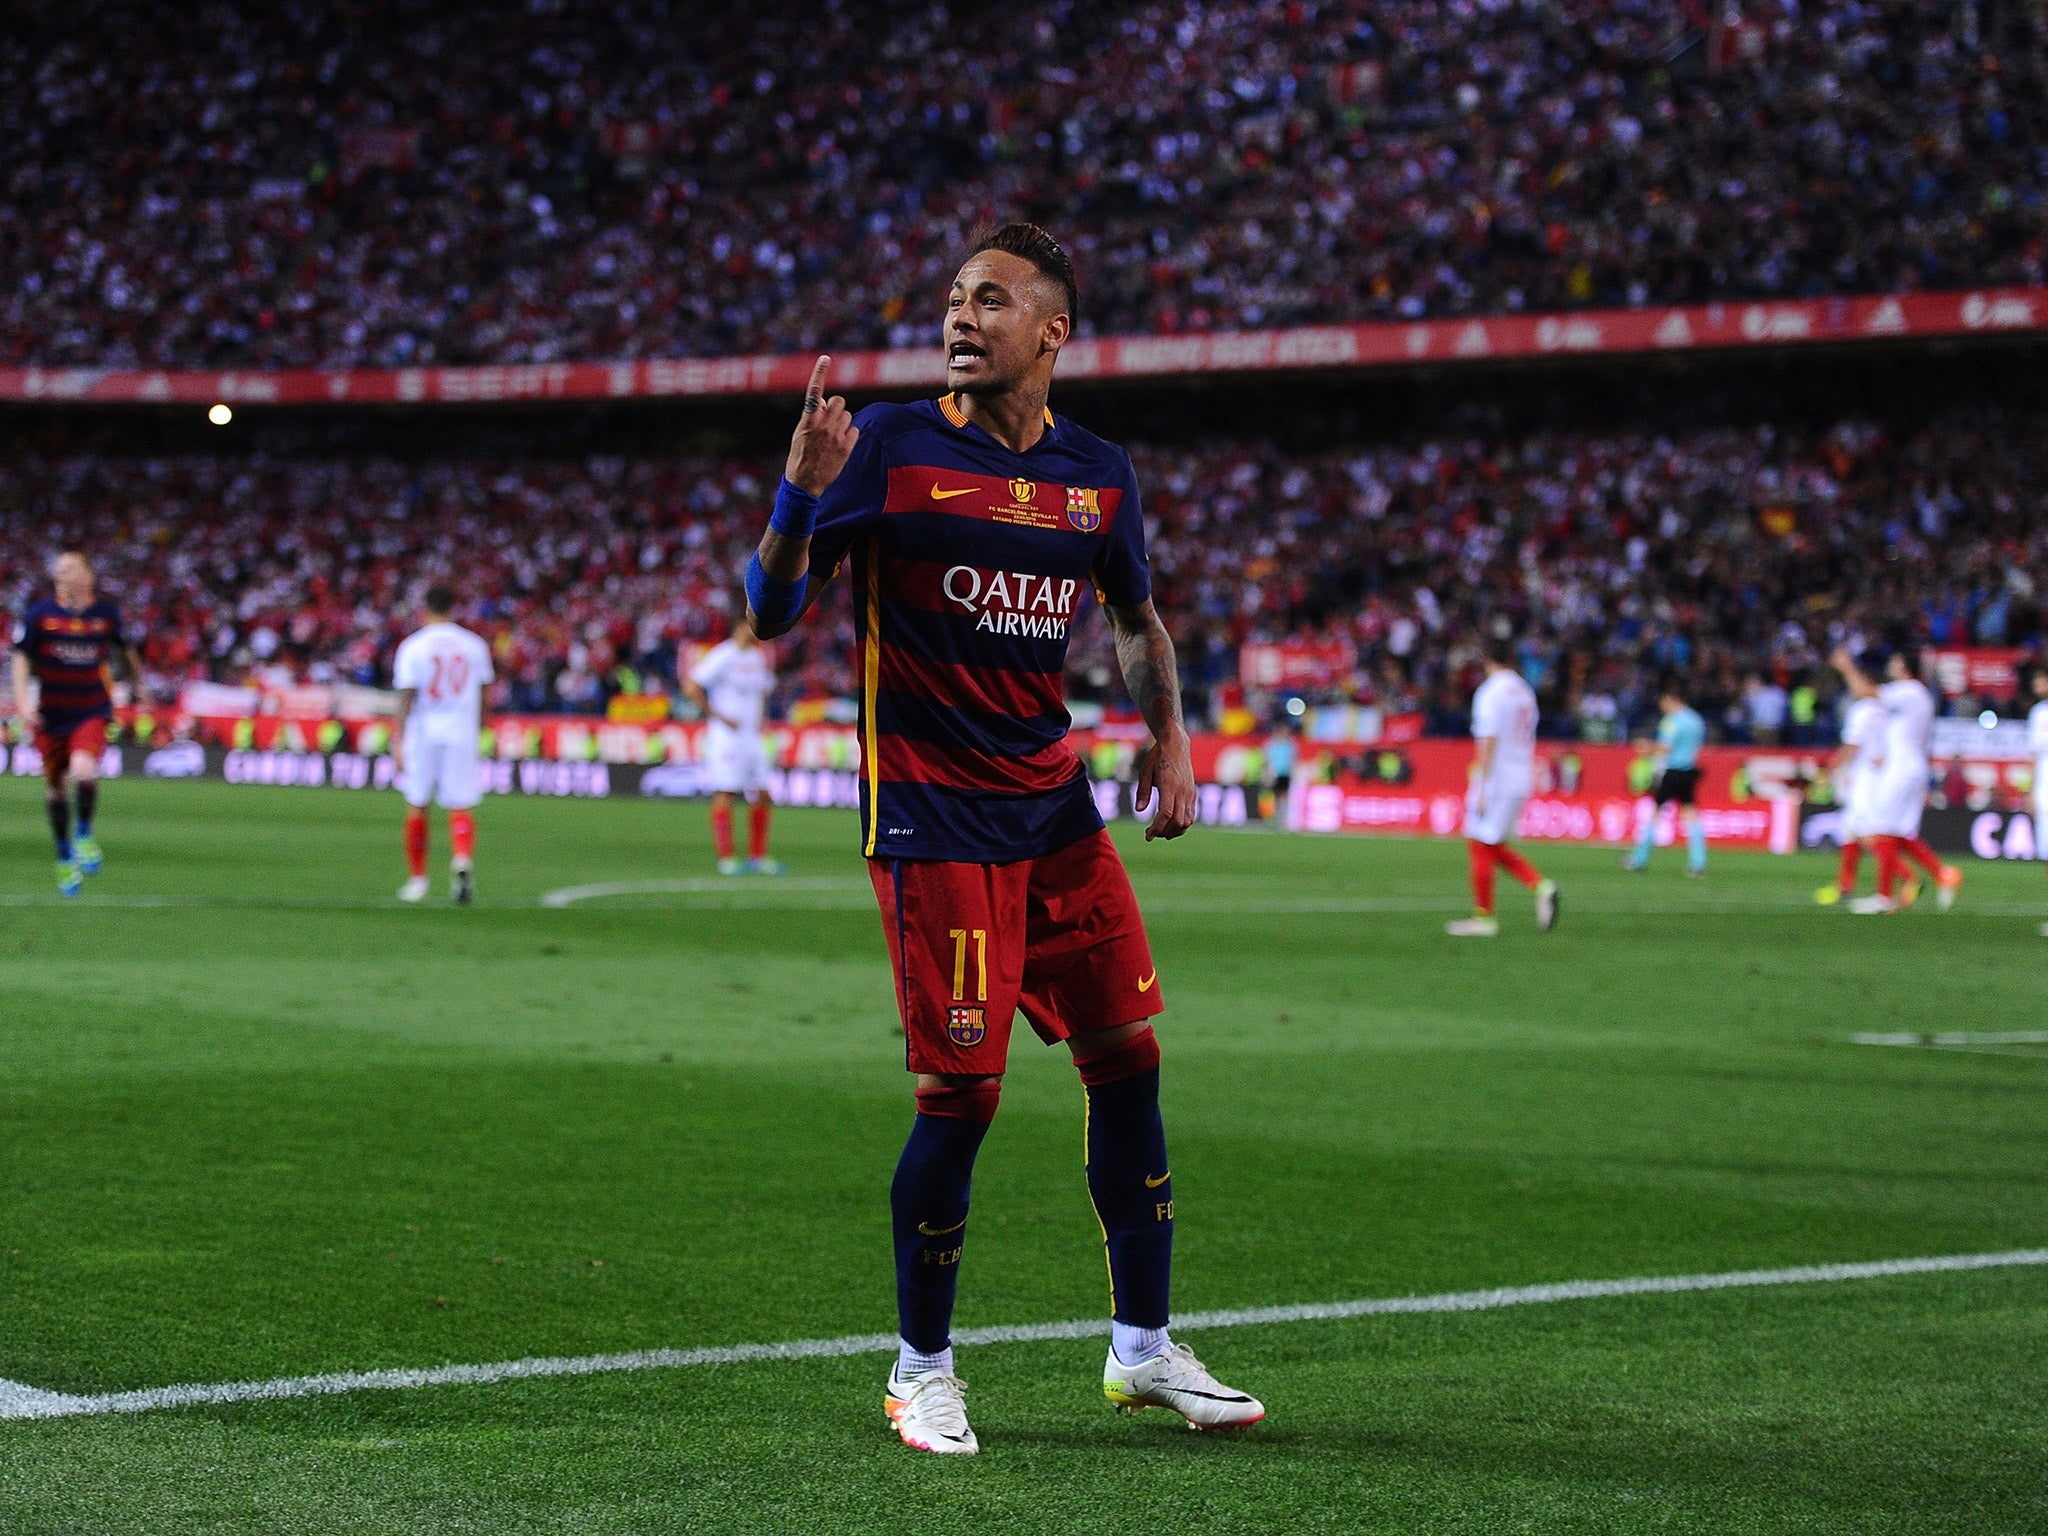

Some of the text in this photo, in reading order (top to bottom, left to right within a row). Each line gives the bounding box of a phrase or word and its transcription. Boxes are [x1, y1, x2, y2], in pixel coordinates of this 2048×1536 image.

[997, 507, 1027, 516] BARCELONA
[943, 565, 1075, 614] QATAR
[976, 609, 1067, 639] AIRWAYS
[428, 655, 470, 700] 20
[949, 929, 987, 1001] 11
[923, 1246, 962, 1265] FCB
